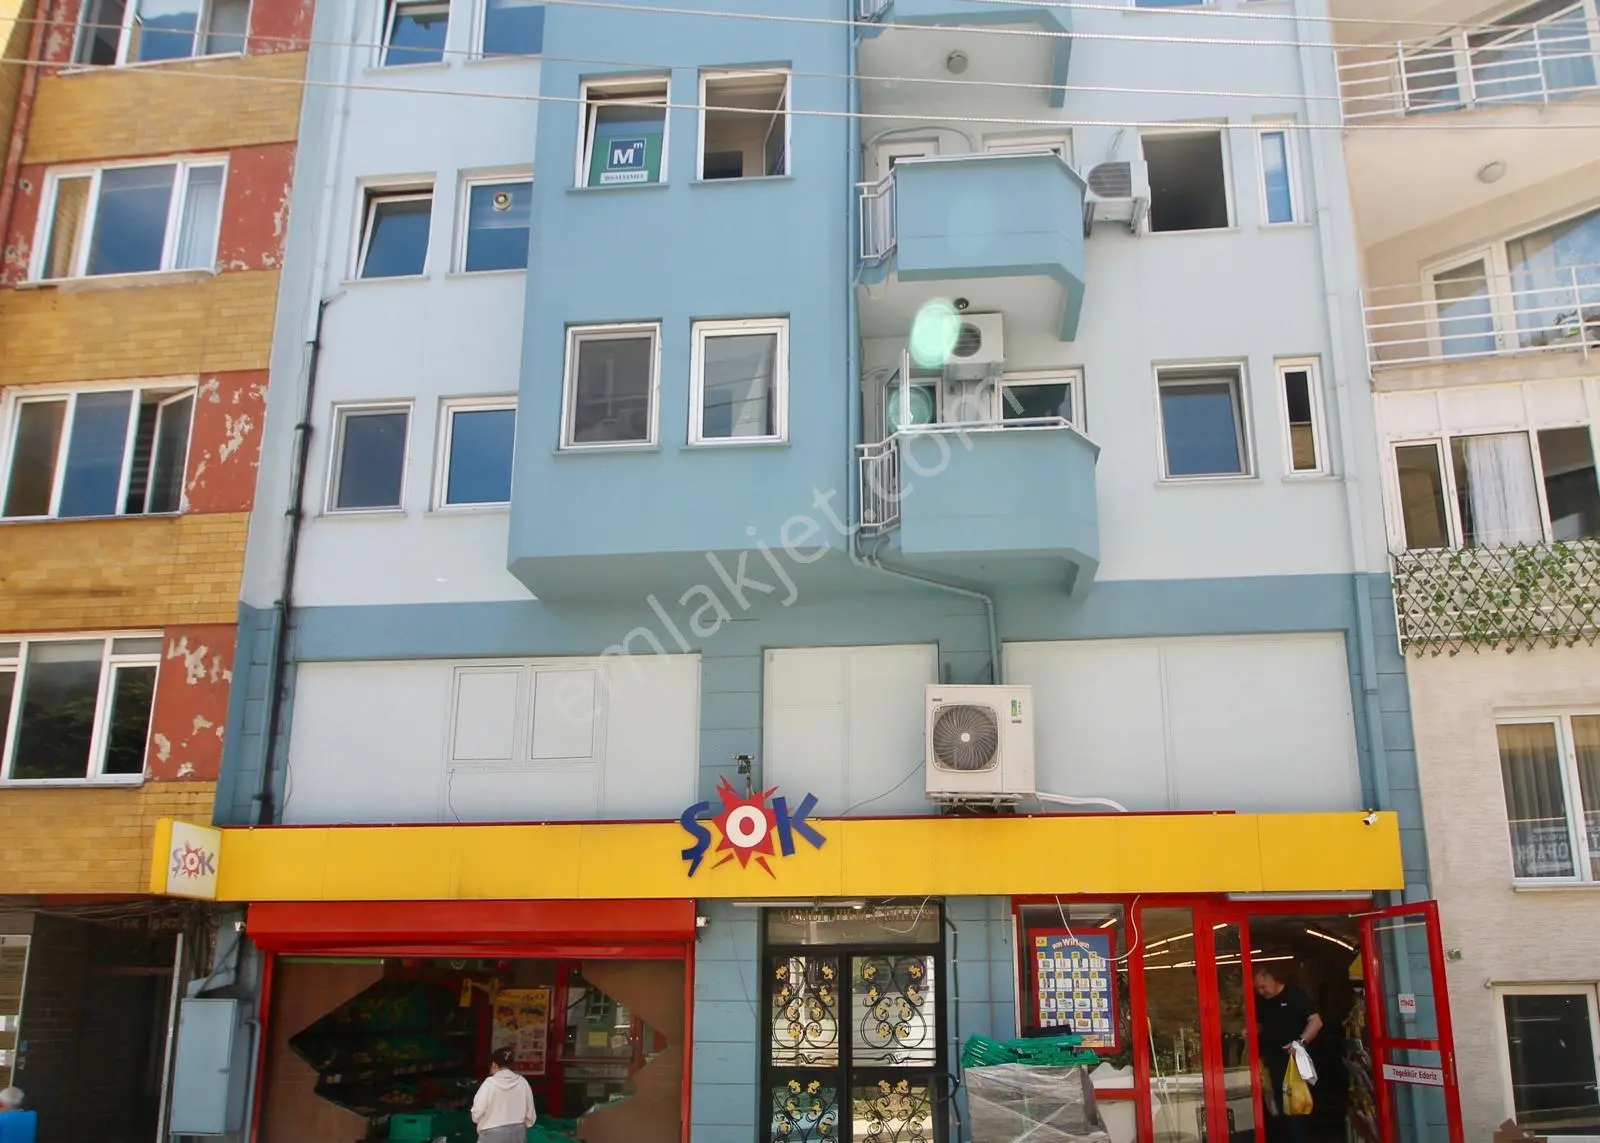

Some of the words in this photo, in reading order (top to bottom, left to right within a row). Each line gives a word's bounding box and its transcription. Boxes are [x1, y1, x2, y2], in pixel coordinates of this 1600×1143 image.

[680, 793, 828, 878] ŞOK
[171, 847, 215, 878] ŞOK
[1392, 1068, 1418, 1079] Teşekkür
[1419, 1071, 1438, 1081] Ederiz
